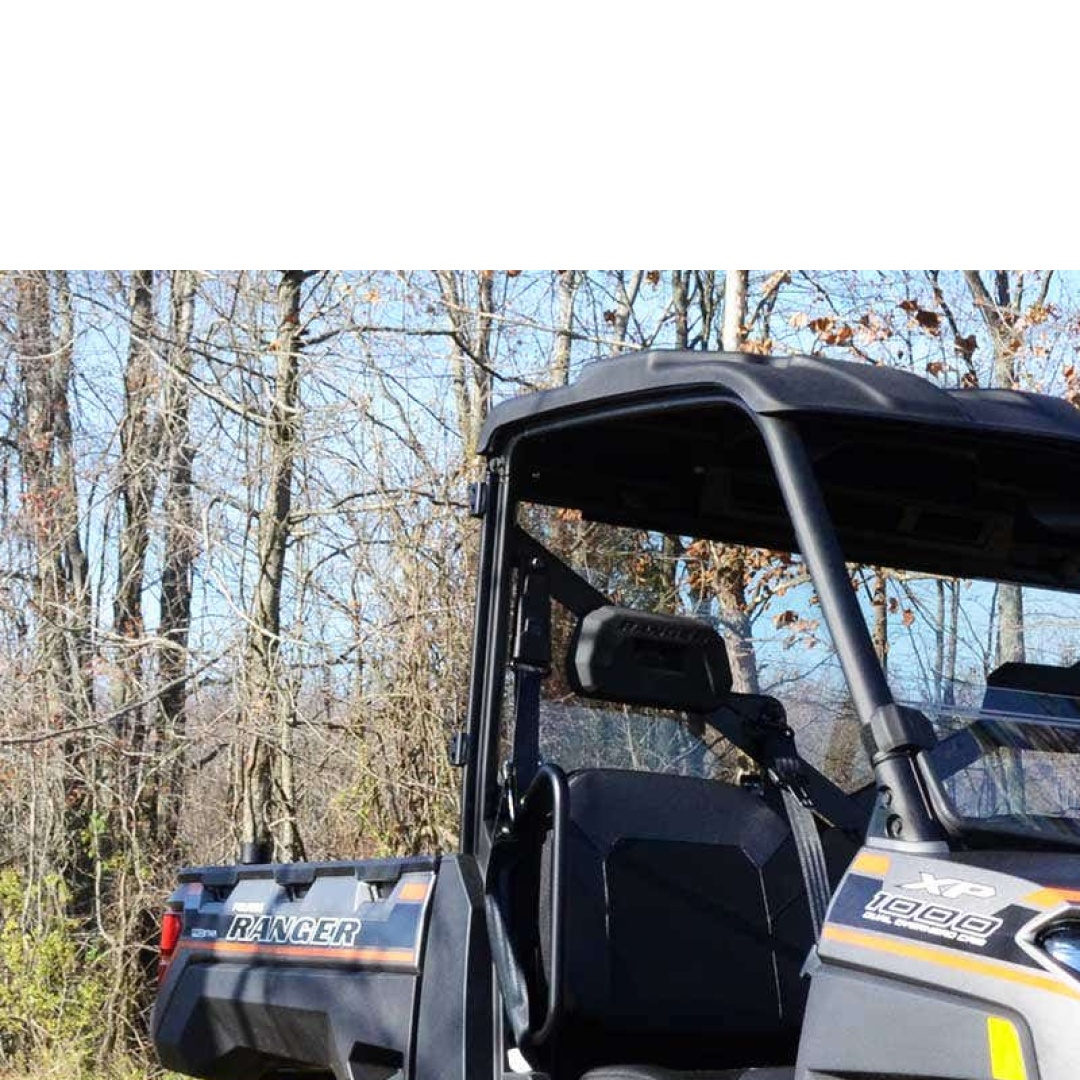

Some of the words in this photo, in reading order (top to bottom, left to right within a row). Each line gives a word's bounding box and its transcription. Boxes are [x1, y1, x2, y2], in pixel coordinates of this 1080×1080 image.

[898, 872, 997, 898] XP
[225, 913, 362, 947] RANGER
[865, 890, 1003, 938] 1000
